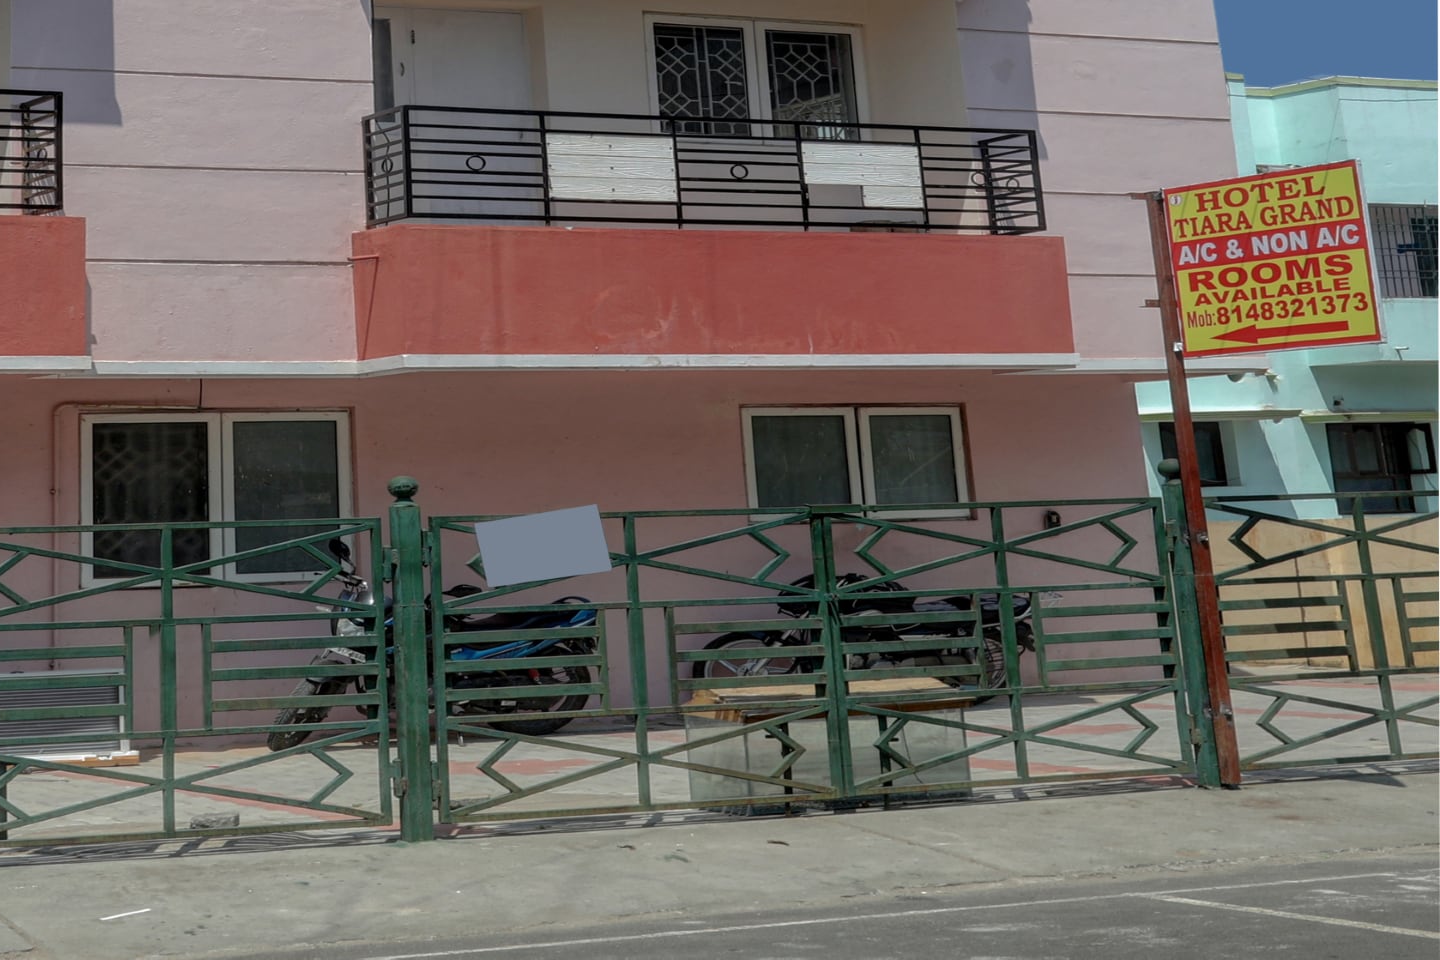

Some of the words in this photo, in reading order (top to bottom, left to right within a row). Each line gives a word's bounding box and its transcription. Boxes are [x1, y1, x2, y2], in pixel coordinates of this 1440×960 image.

[1194, 176, 1326, 212] HOTEL
[1174, 210, 1253, 238] TIARA
[1260, 195, 1355, 227] GRAND
[1178, 242, 1218, 266] A/C
[1225, 239, 1244, 259] &
[1251, 230, 1309, 256] NON
[1317, 224, 1360, 249] A/C
[1188, 254, 1353, 292] ROOMS
[1194, 277, 1352, 307] AVAILABLE
